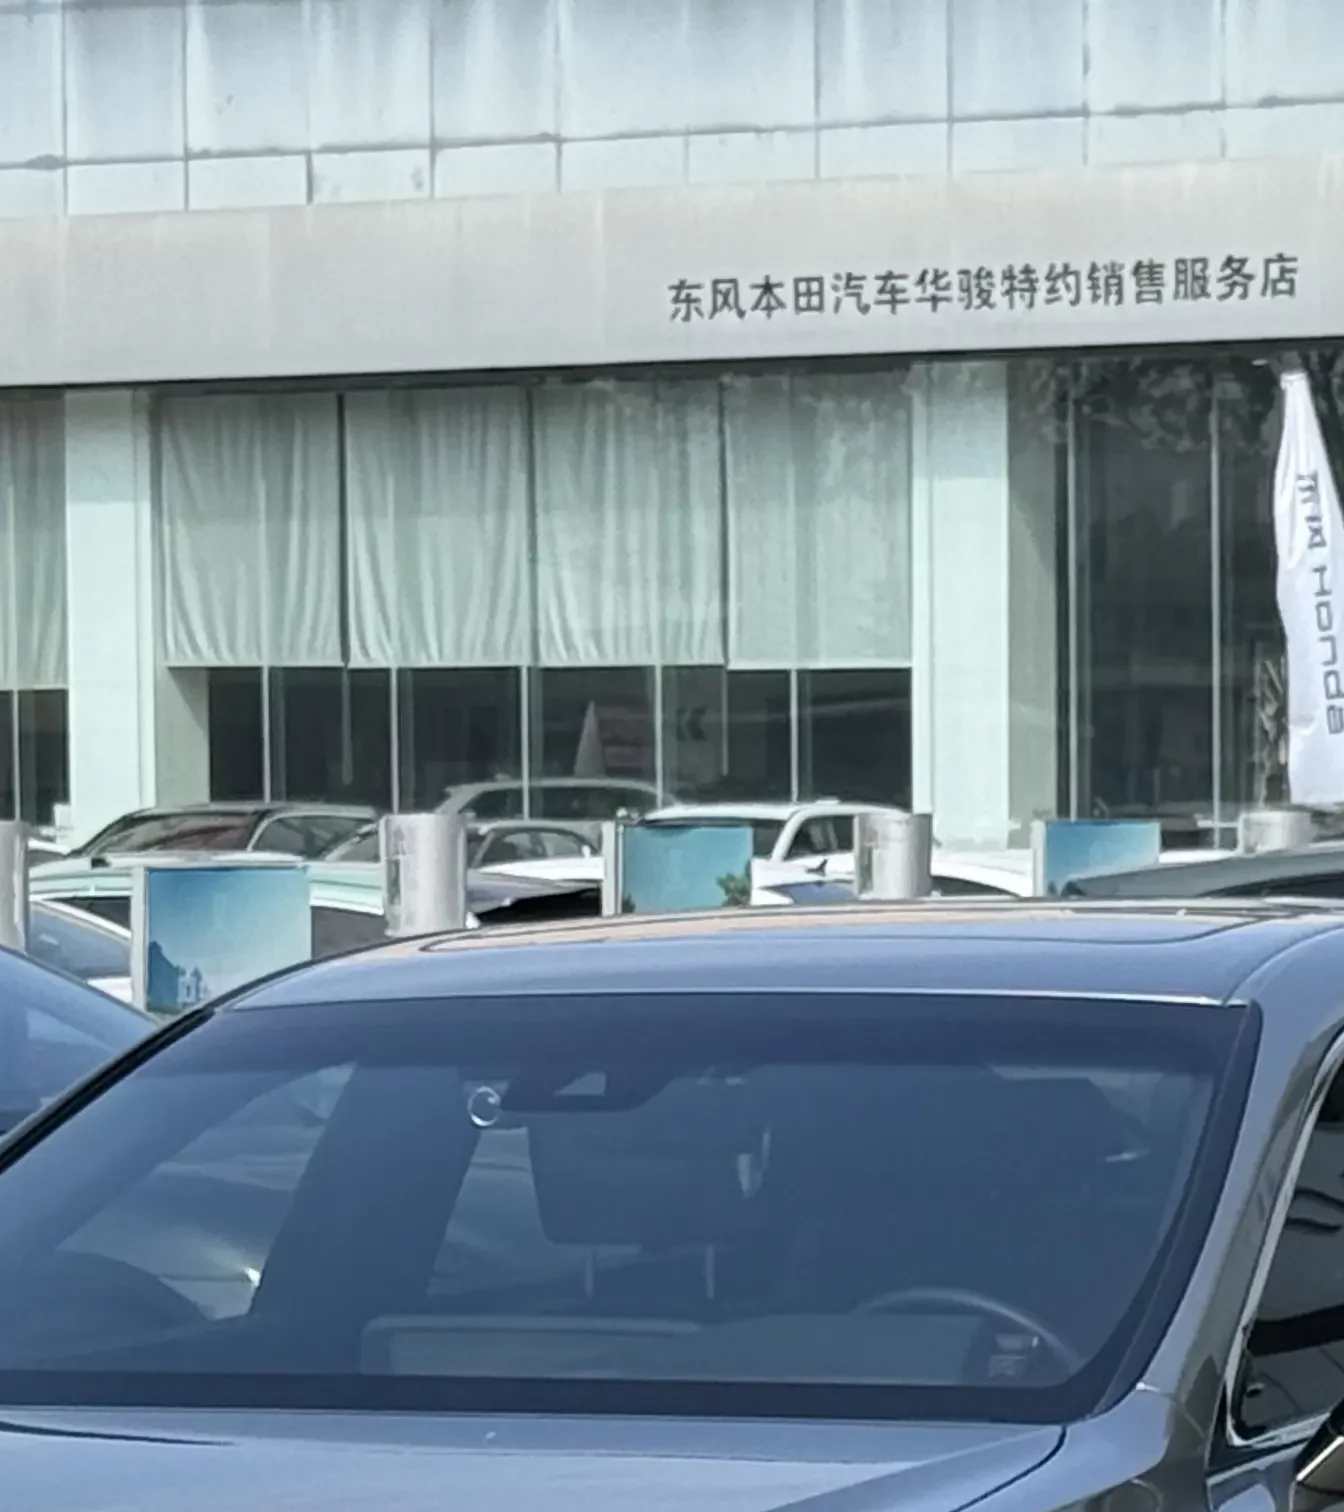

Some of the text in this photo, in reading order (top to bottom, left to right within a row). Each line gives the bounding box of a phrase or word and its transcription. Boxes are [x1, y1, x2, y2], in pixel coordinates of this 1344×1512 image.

[666, 252, 1300, 323] 东风本田汽车华骏特约销售服务店
